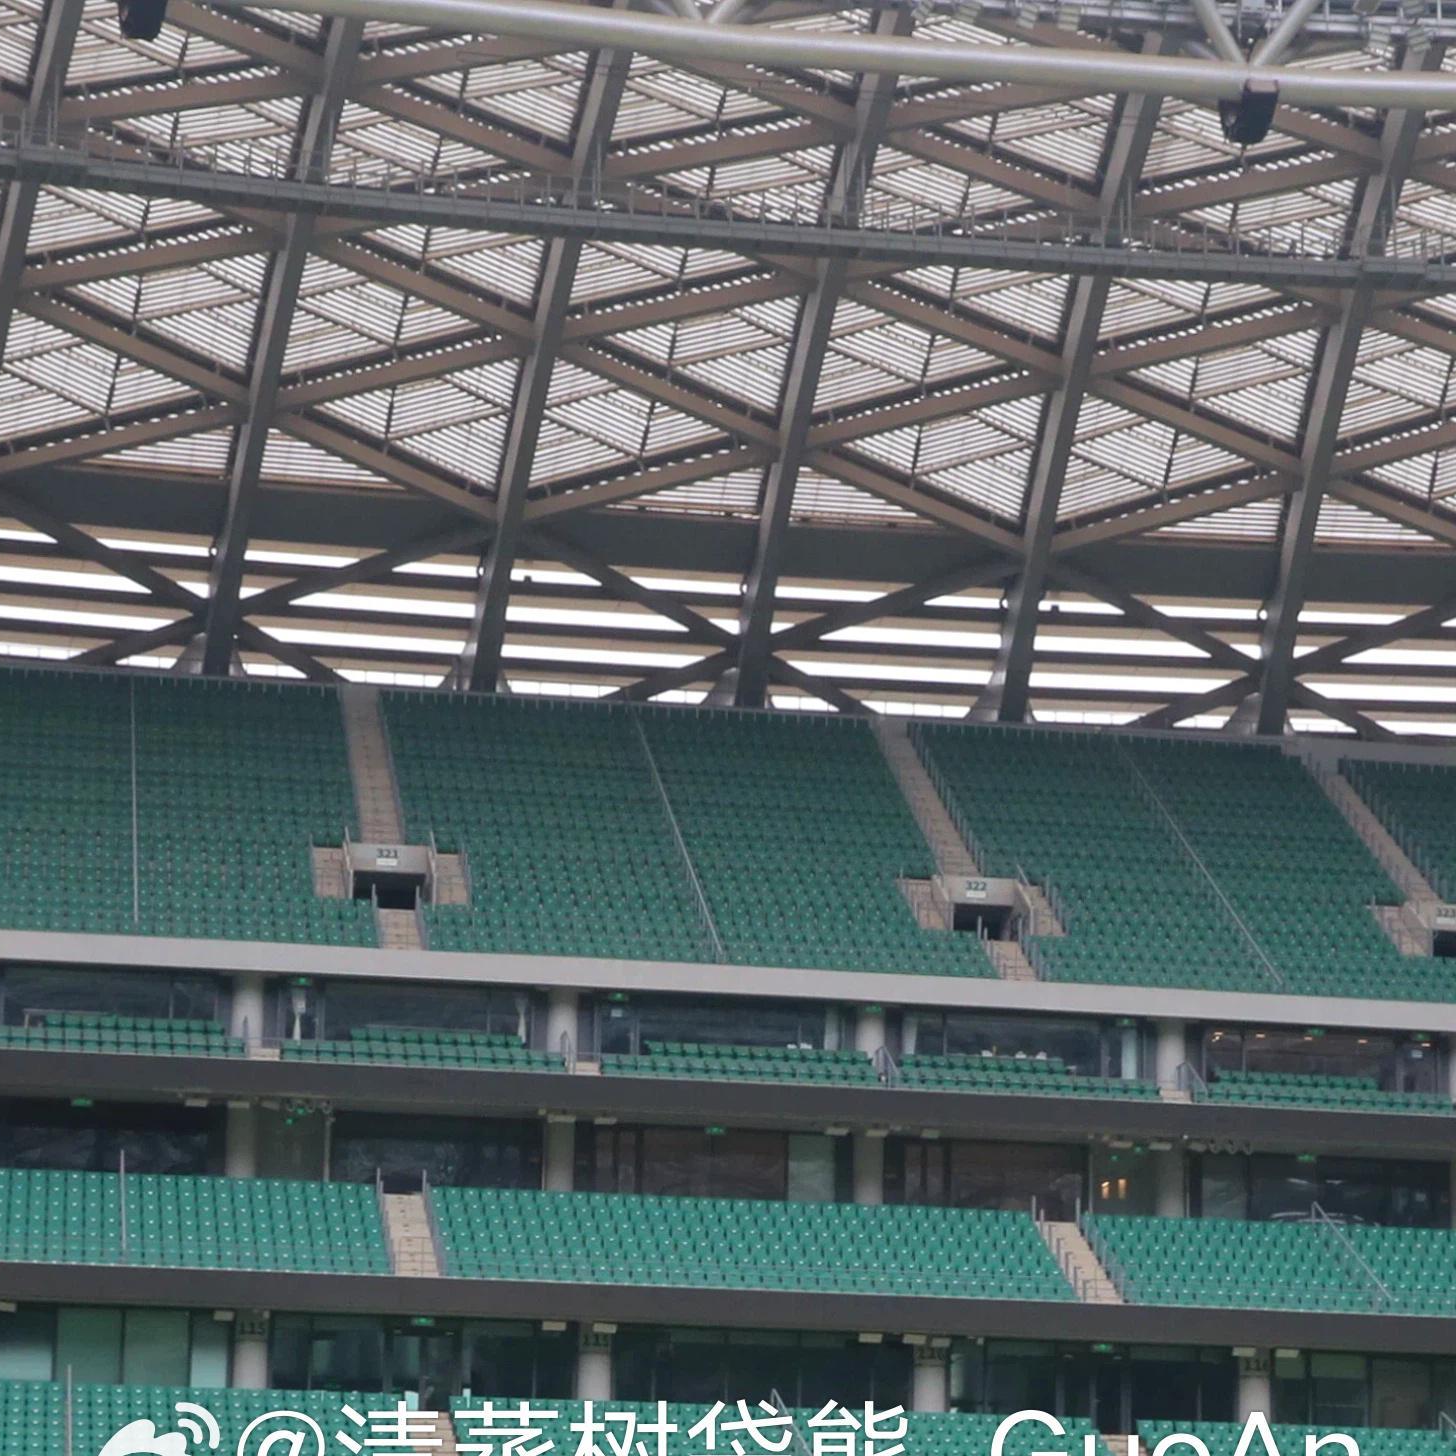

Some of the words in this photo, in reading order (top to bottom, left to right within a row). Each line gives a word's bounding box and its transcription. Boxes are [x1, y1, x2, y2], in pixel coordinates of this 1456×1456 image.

[376, 848, 399, 859] 321
[965, 880, 988, 891] 322
[1436, 907, 1456, 918] 323
